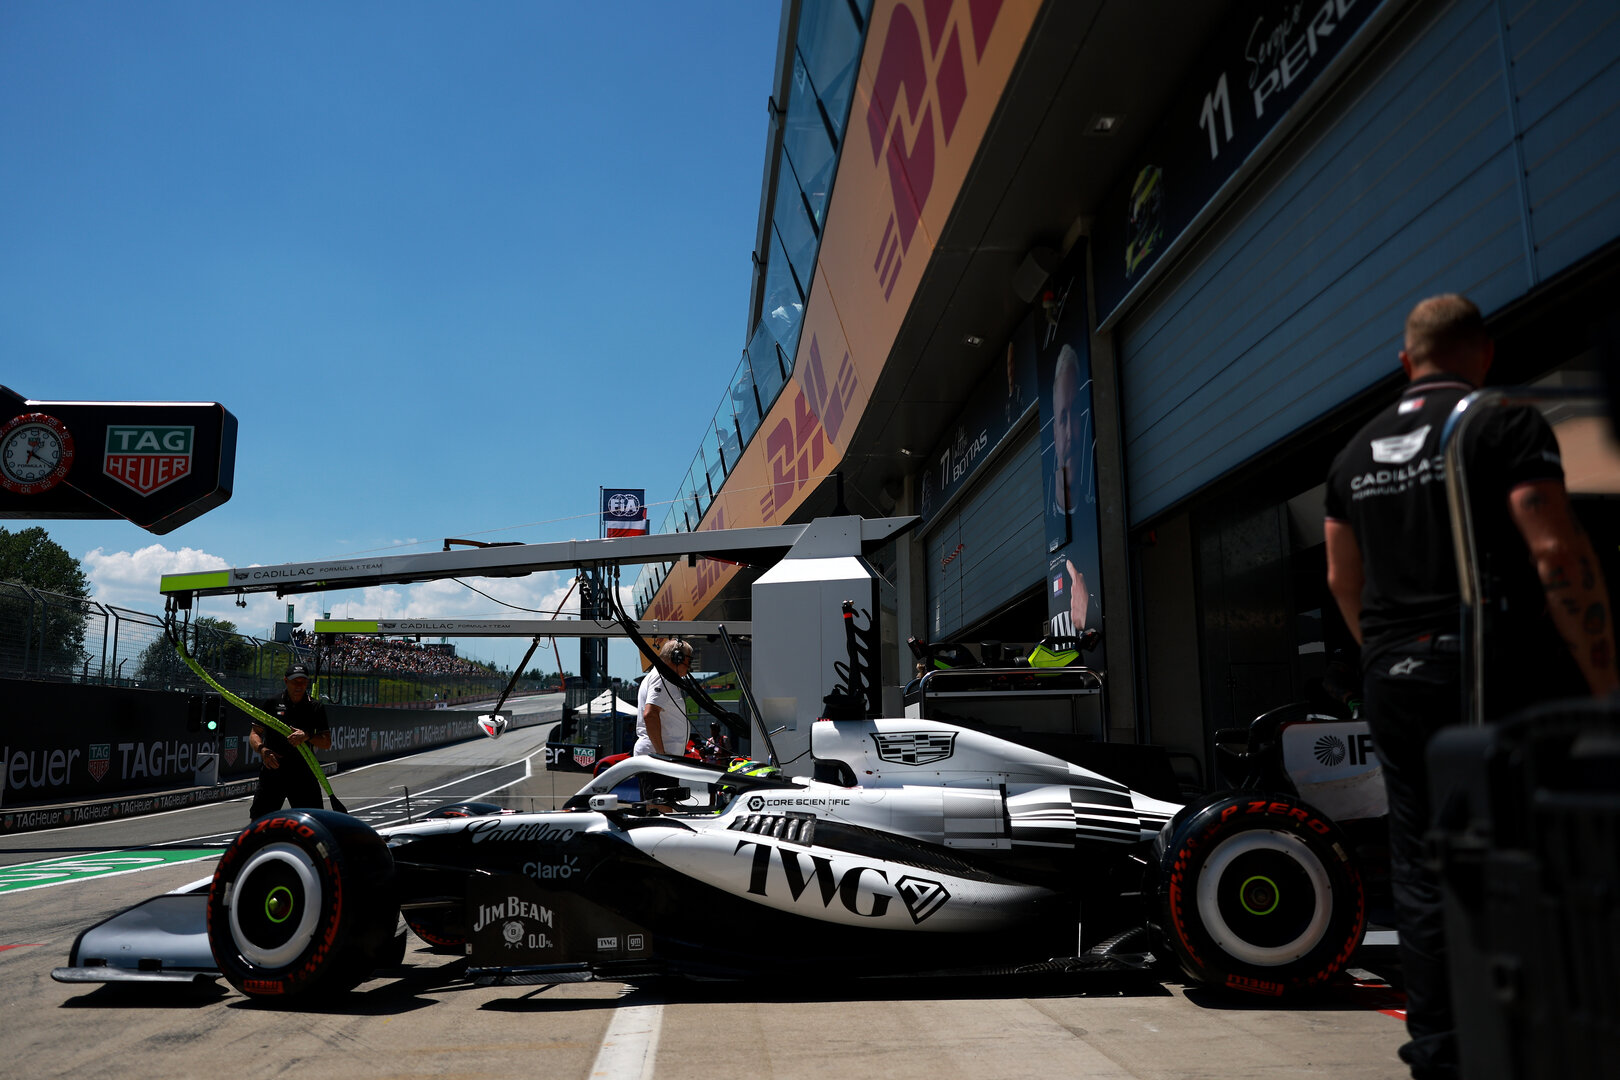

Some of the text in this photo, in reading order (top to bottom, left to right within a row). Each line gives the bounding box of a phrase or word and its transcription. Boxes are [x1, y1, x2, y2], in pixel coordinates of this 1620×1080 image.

[1199, 70, 1234, 161] 11
[767, 331, 846, 513] DHL
[114, 430, 185, 450] TAG
[953, 429, 988, 483] BOTTAS
[108, 457, 186, 489] HEUER
[253, 567, 314, 579] CADILLAC
[319, 565, 354, 573] FORMULA
[329, 726, 370, 750] AGHeuer
[380, 729, 413, 751] TAGHeuer
[421, 725, 447, 744] TAGHeuer
[91, 746, 109, 758] TAG
[576, 748, 594, 757] TAG
[73, 805, 112, 821] TAGHeuer
[121, 800, 153, 815] TAGHeuer
[1221, 800, 1331, 835] P ZERO
[16, 812, 62, 828] TAGHeuer
[254, 817, 316, 838] ZERO
[463, 819, 573, 844] Cadillac
[522, 861, 572, 880] Claro
[733, 840, 893, 917] TWG
[473, 896, 553, 933] JIM BEAM
[528, 933, 554, 949] 0.0%
